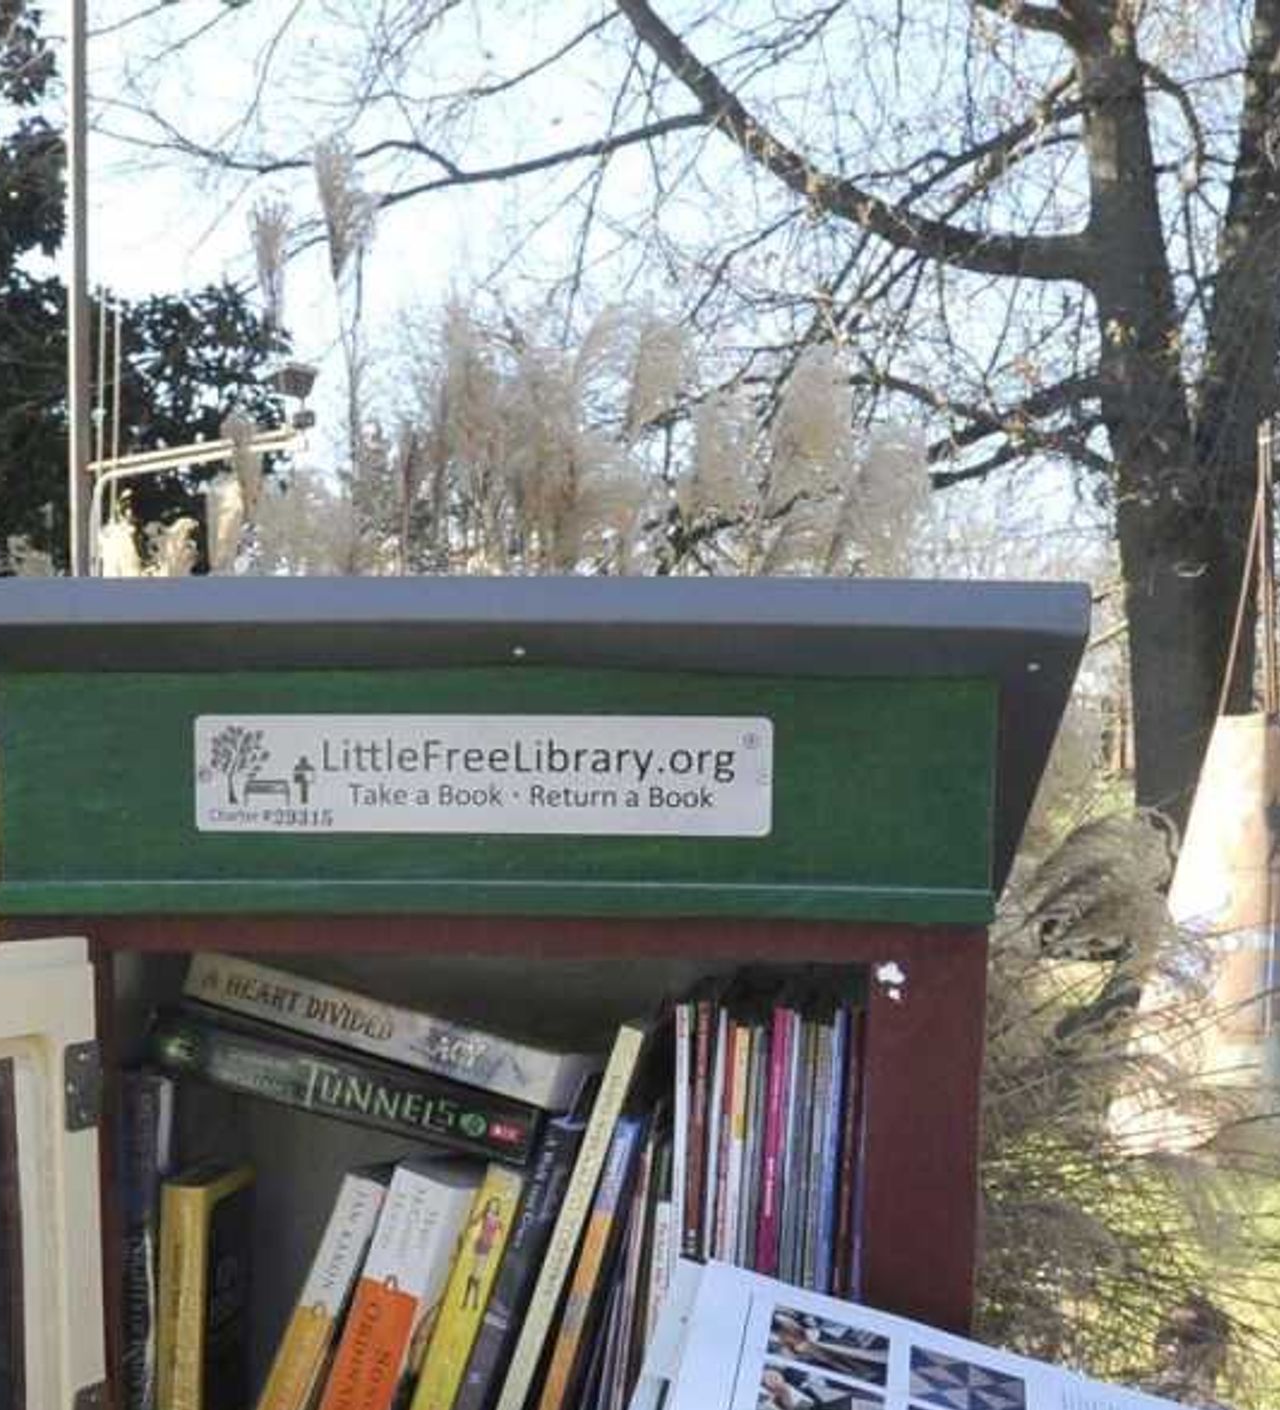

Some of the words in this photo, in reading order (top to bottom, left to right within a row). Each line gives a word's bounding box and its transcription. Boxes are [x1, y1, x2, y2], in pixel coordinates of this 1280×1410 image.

[321, 738, 735, 781] LittleFreeLibrary.org
[349, 784, 408, 806] Take
[416, 788, 430, 805] a
[438, 784, 504, 807] Book
[530, 784, 617, 808] Return
[625, 790, 639, 807] a
[649, 786, 714, 808] Book
[224, 977, 300, 1016] HEART
[306, 998, 395, 1040] DIVIDED
